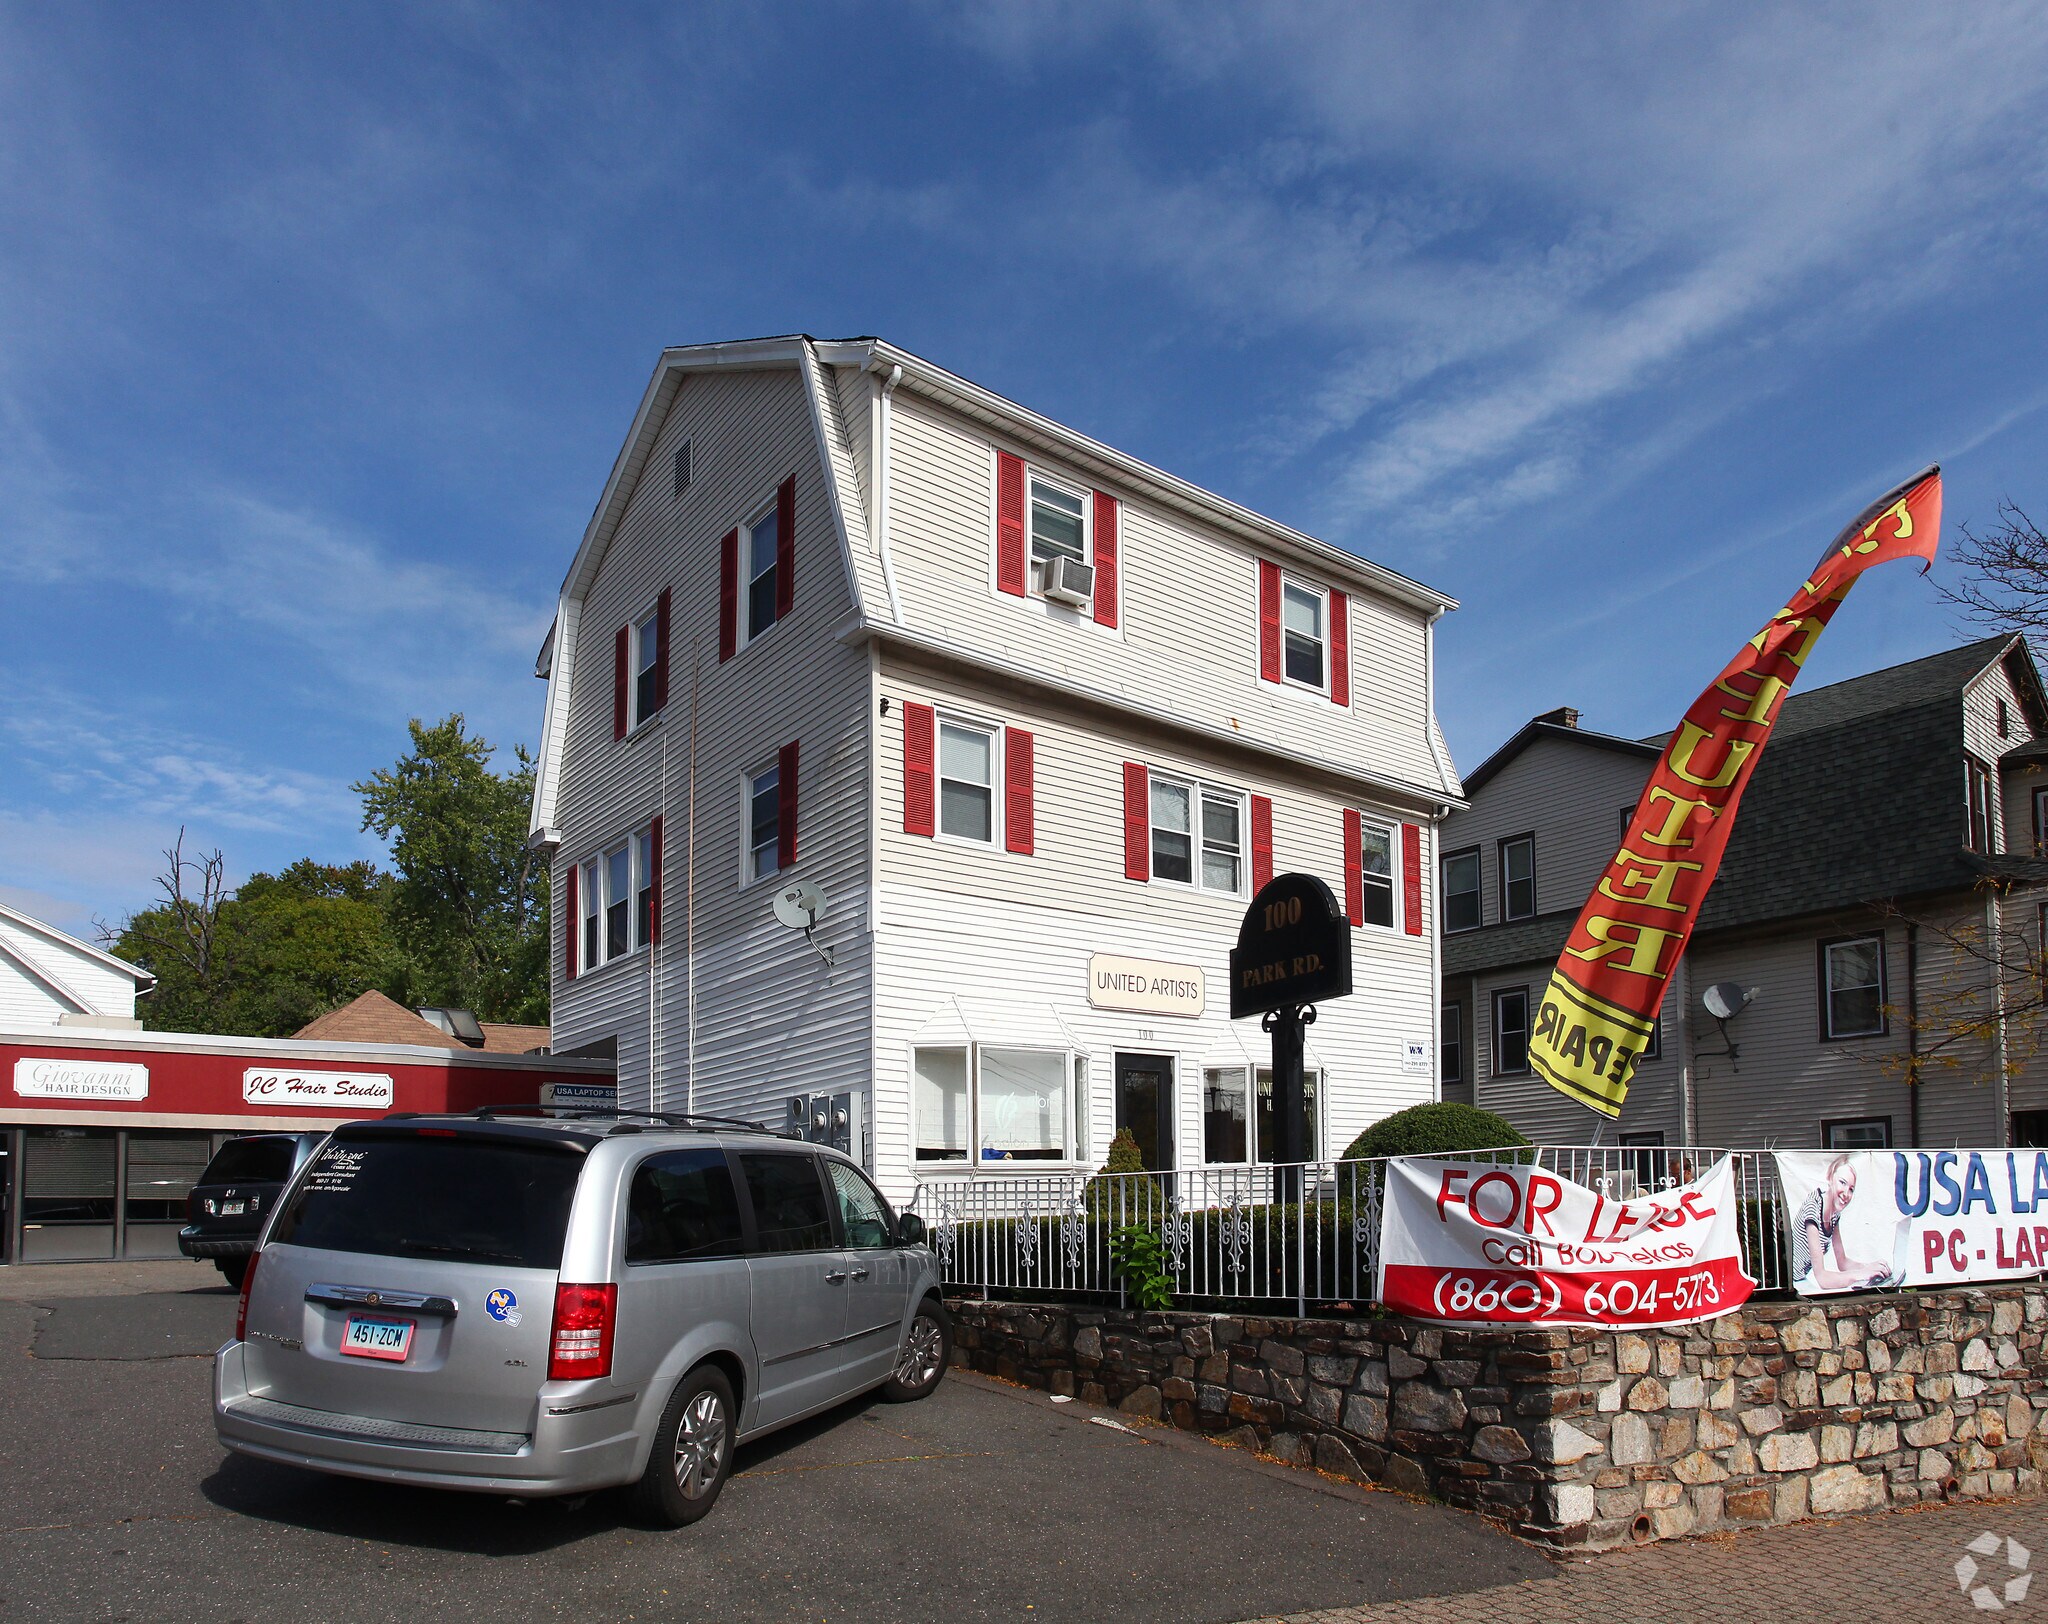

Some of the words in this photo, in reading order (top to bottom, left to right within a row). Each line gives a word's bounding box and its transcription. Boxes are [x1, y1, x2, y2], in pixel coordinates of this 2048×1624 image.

[1264, 896, 1301, 932] 100
[1097, 971, 1147, 993] UNITED
[1151, 978, 1198, 1000] ARTISTS
[1243, 961, 1287, 988] PARK
[1293, 954, 1324, 976] RD.
[33, 1063, 133, 1089] Giovanni
[45, 1083, 79, 1094] HAIR
[82, 1085, 131, 1096] DESIGN
[247, 1076, 278, 1096] JC
[285, 1078, 328, 1095] Hair
[333, 1080, 388, 1097] Studio
[557, 1087, 573, 1095] USA
[574, 1088, 603, 1097] LAPTOP
[1894, 1152, 1997, 1217] USA
[1437, 1169, 1562, 1237] FOR
[1481, 1237, 1543, 1267] Call
[1434, 1271, 1562, 1318] (860)
